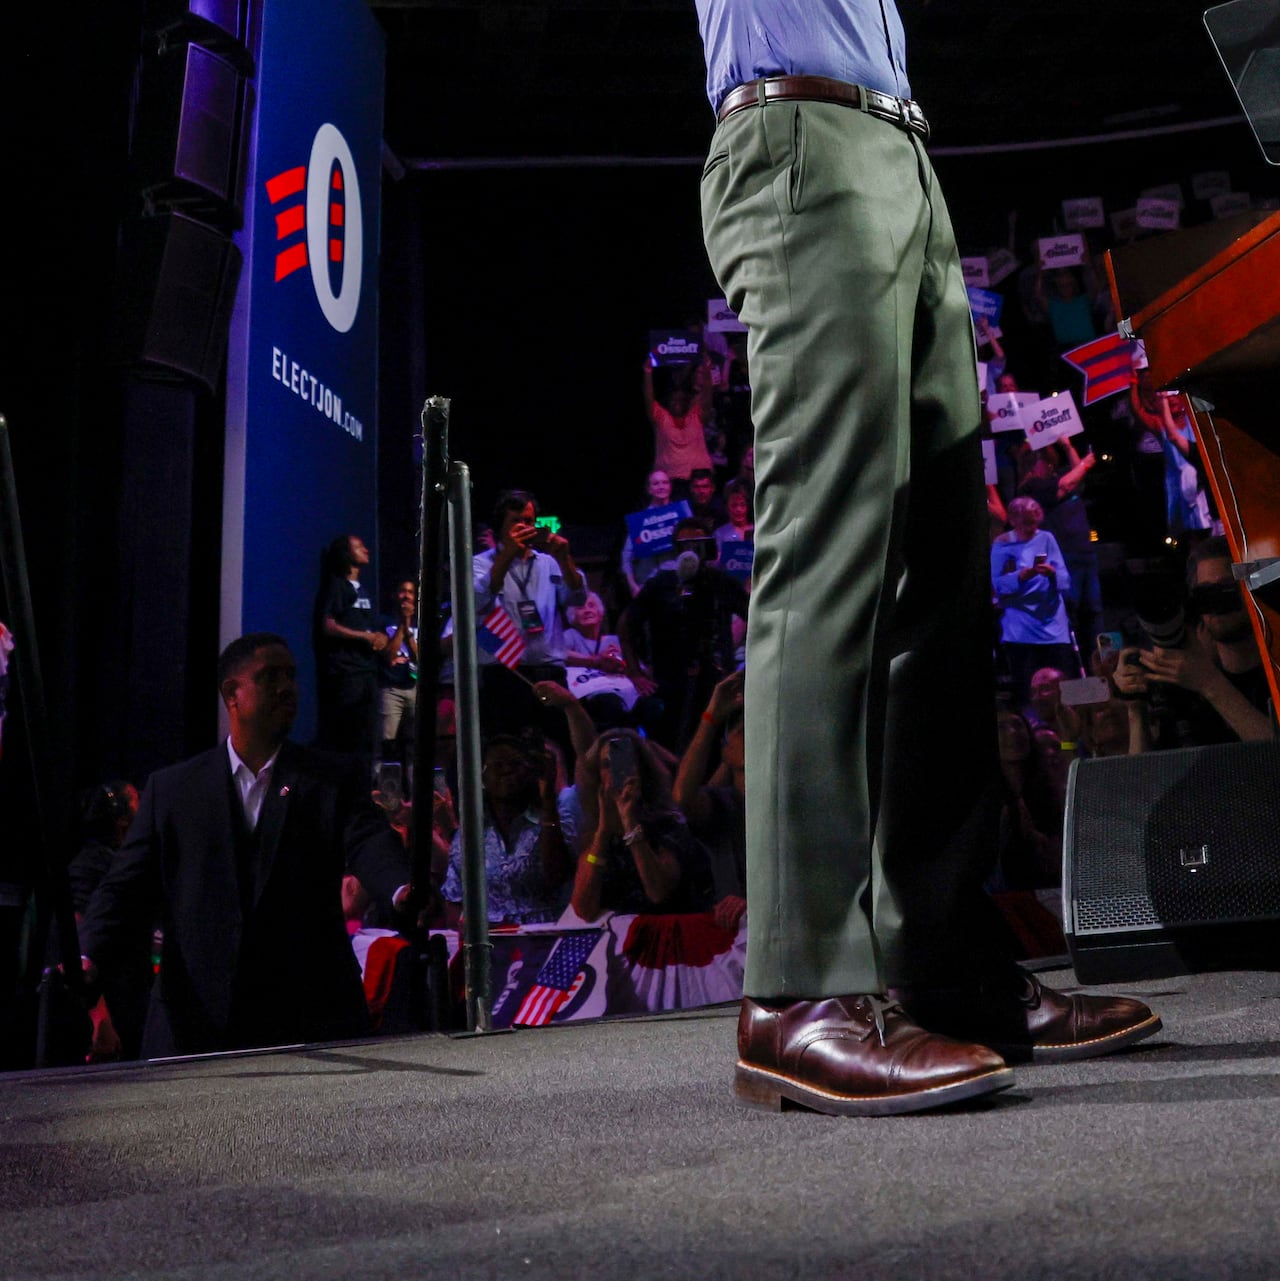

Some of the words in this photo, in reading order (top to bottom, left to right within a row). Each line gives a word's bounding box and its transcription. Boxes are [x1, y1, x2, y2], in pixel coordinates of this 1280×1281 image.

[272, 345, 364, 442] ELECTJON.COM
[1033, 409, 1072, 433] Ossoff
[1041, 408, 1059, 419] Jon
